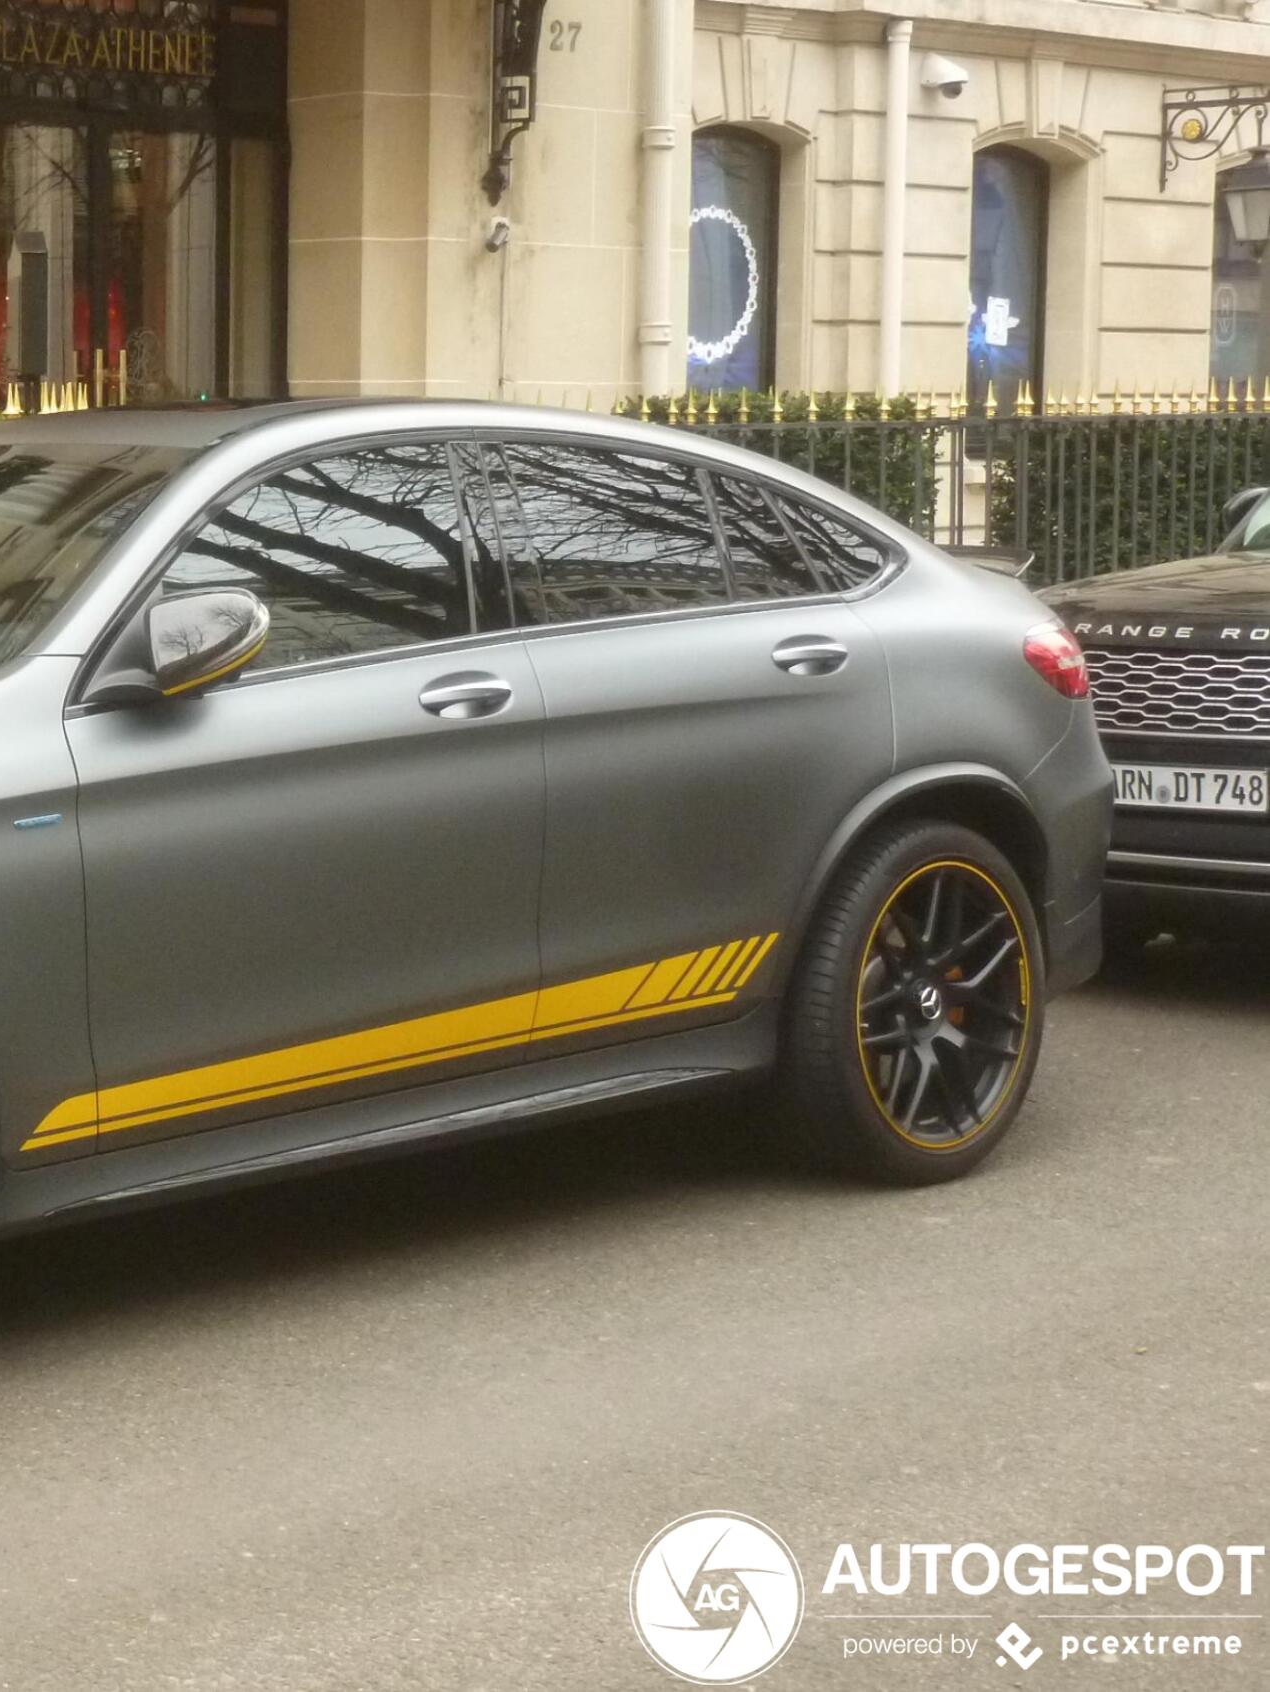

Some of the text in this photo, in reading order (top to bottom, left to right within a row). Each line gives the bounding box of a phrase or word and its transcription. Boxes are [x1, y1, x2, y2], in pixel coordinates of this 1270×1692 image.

[549, 19, 582, 52] 27
[1074, 623, 1194, 639] RANGE
[1173, 772, 1206, 803] DT
[1214, 774, 1264, 806] 748
